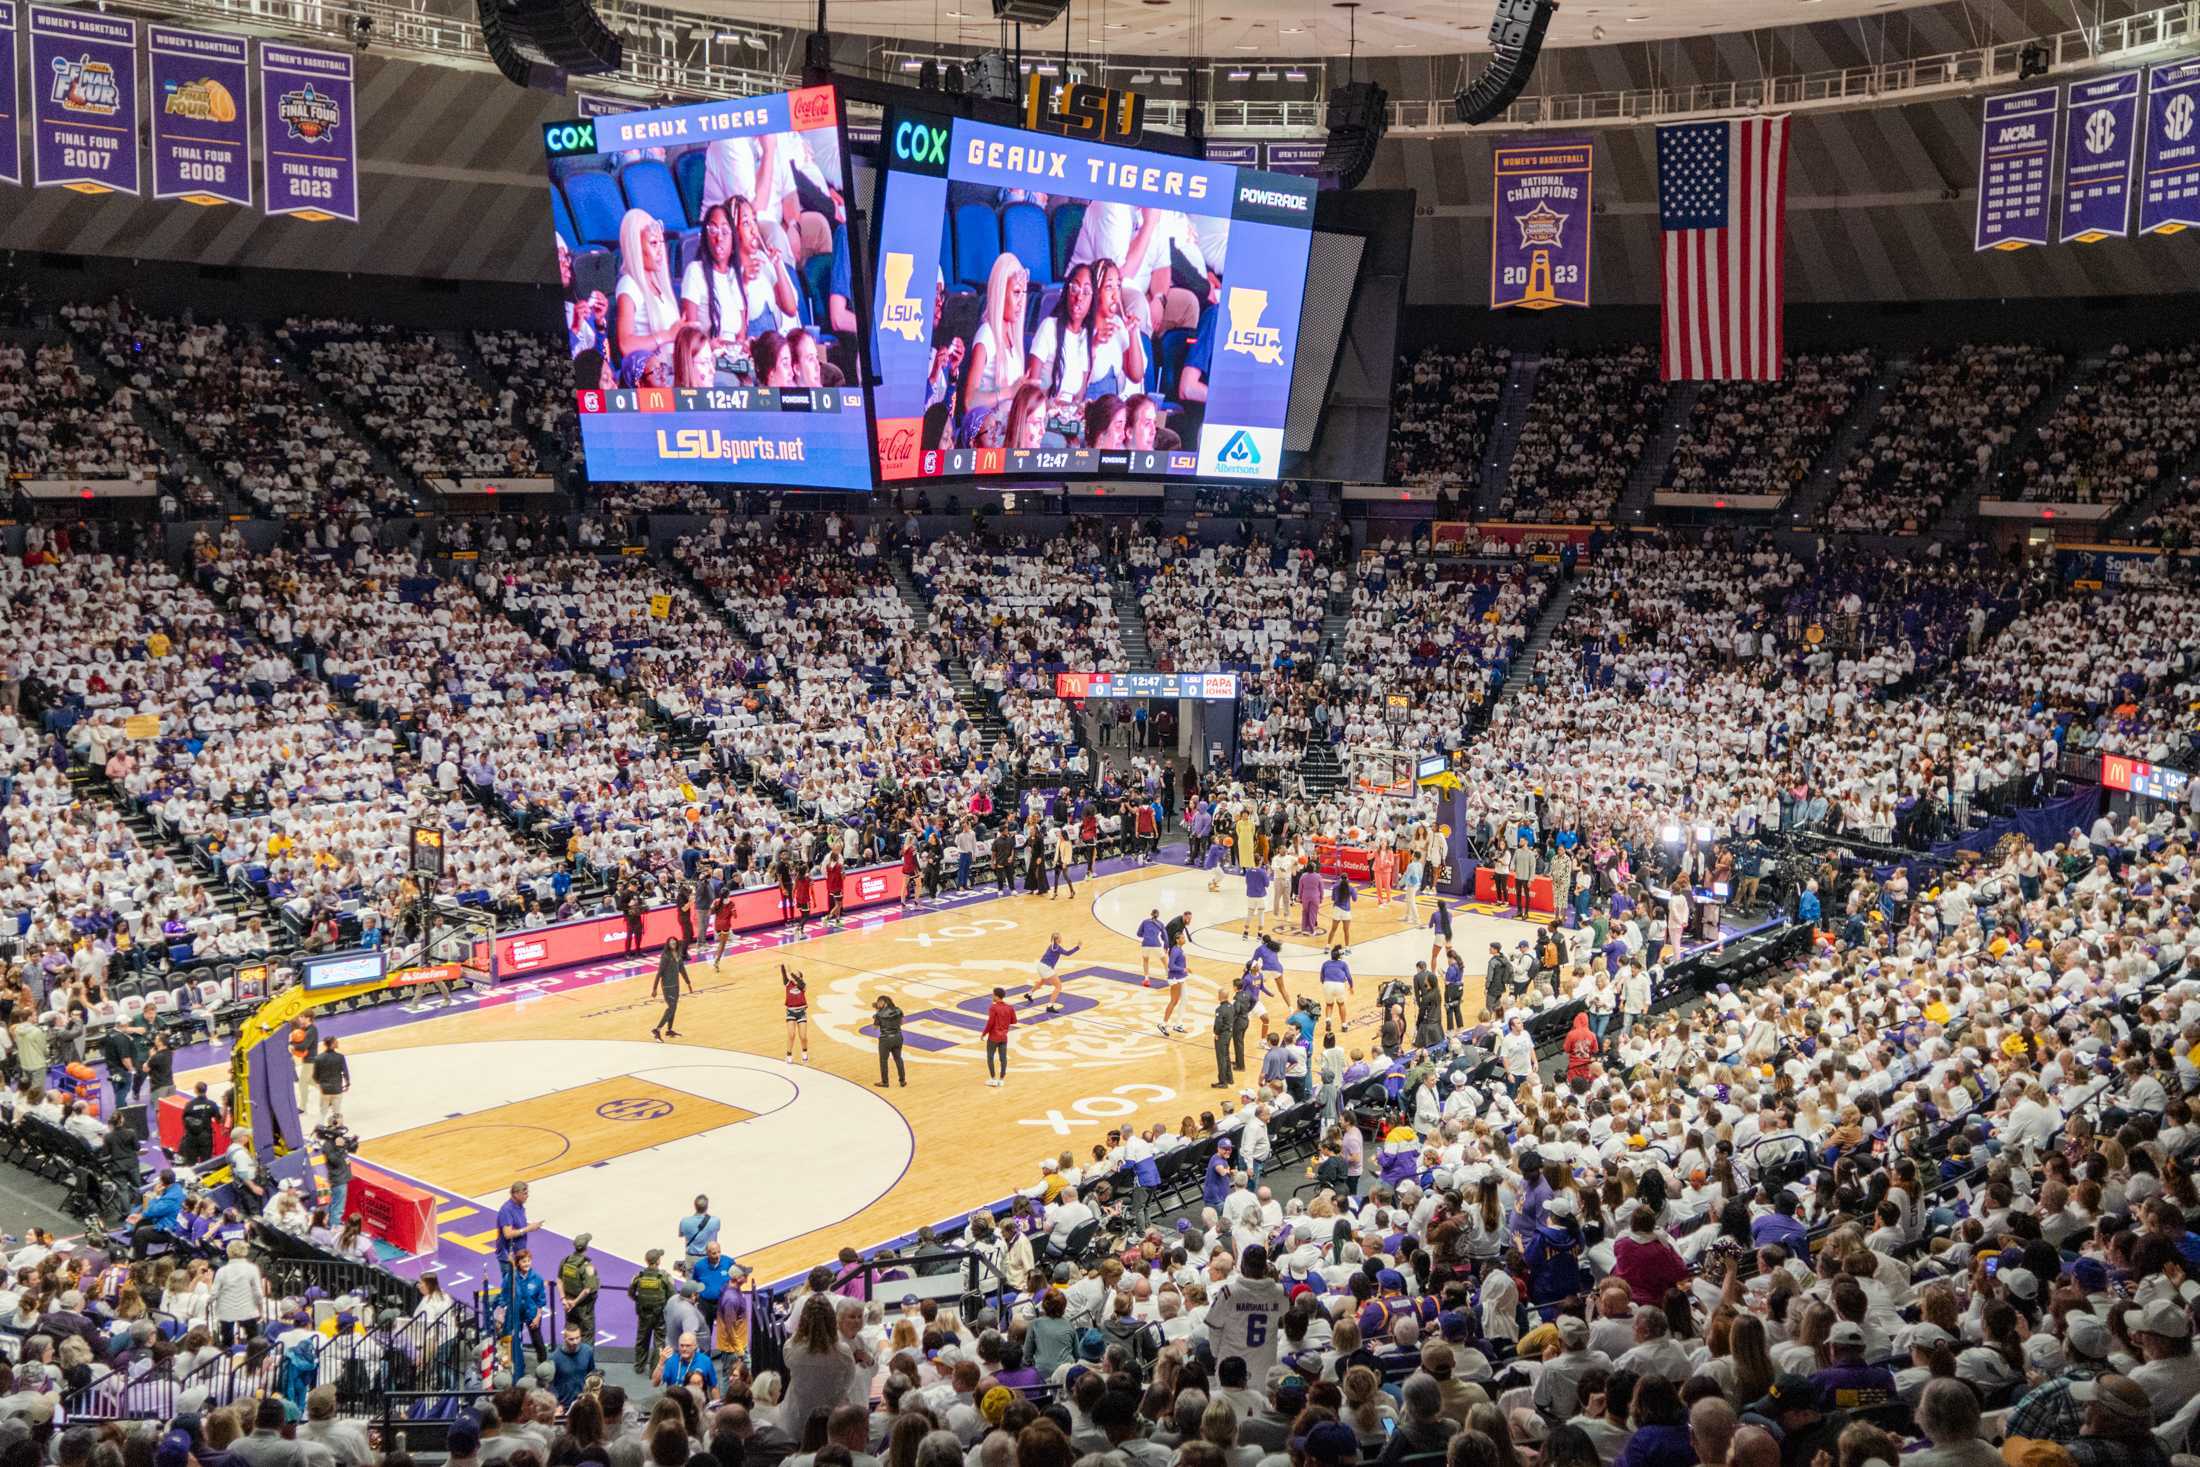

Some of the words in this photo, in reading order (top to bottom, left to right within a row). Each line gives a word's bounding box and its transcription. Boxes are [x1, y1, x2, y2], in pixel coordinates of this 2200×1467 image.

[38, 15, 77, 29] WOMEN'S
[79, 21, 128, 37] BASKETBALL
[156, 34, 192, 48] WOMEN'S
[195, 39, 240, 54] BASKETBALL
[268, 52, 301, 66] WOMEN'S
[304, 56, 346, 71] BASKETBALL
[2087, 82, 2120, 96] VOLLEYBALL
[281, 104, 308, 118] FINAL
[311, 107, 337, 123] FOUR
[794, 95, 829, 120] Coca-Cola
[1026, 72, 1145, 147] LSU
[2004, 99, 2037, 111] VOLLEYBALL
[699, 108, 769, 132] TIGERS
[2164, 94, 2195, 141] SEC
[547, 124, 595, 151] COX
[1999, 124, 2036, 143] NCAA
[2085, 109, 2116, 154] SEC
[55, 132, 86, 146] FINAL
[89, 136, 118, 150] FOUR
[896, 121, 948, 165] COX
[64, 148, 110, 170] 2007
[172, 147, 202, 160] FINAL
[204, 150, 232, 163] FOUR
[1503, 156, 1537, 166] WOMEN'S
[1539, 154, 1584, 166] BASKETBALL
[2160, 145, 2195, 160] CHAMPIONS
[180, 162, 226, 182] 2008
[283, 163, 310, 177] FINAL
[313, 167, 338, 180] FOUR
[968, 139, 1067, 178] GEAUX
[1088, 158, 1208, 199] TIGERS
[290, 178, 332, 198] 2023
[1521, 176, 1564, 187] NATIONAL
[1240, 187, 1307, 210] POWERADE
[1507, 187, 1578, 202] CHAMPIONS
[1504, 267, 1527, 284] 20
[1554, 265, 1578, 283] 23
[886, 304, 912, 323] LSU
[1233, 331, 1268, 348] LSU
[615, 395, 626, 409] 0
[688, 398, 694, 410] 1
[707, 390, 748, 409] 12:47
[823, 394, 832, 408] 0
[843, 395, 861, 407] LSU
[656, 429, 804, 464] LSUsports.net
[953, 455, 962, 469] 0
[1018, 458, 1023, 469] 1
[1037, 453, 1069, 467] 12:47
[1145, 455, 1154, 468] 0
[1170, 456, 1195, 469] LSU
[1215, 463, 1260, 475] Albertsons
[1132, 676, 1160, 687] 12:47
[1206, 678, 1232, 688] PAPA
[1096, 686, 1104, 696] 0
[1188, 686, 1197, 696] 0
[1206, 688, 1232, 696] JOHNS
[2136, 776, 2143, 791] 0
[1017, 1083, 1177, 1136] COX
[1236, 1303, 1269, 1312] MARSHALL
[1271, 1303, 1279, 1312] JR
[1246, 1313, 1268, 1348] 6
